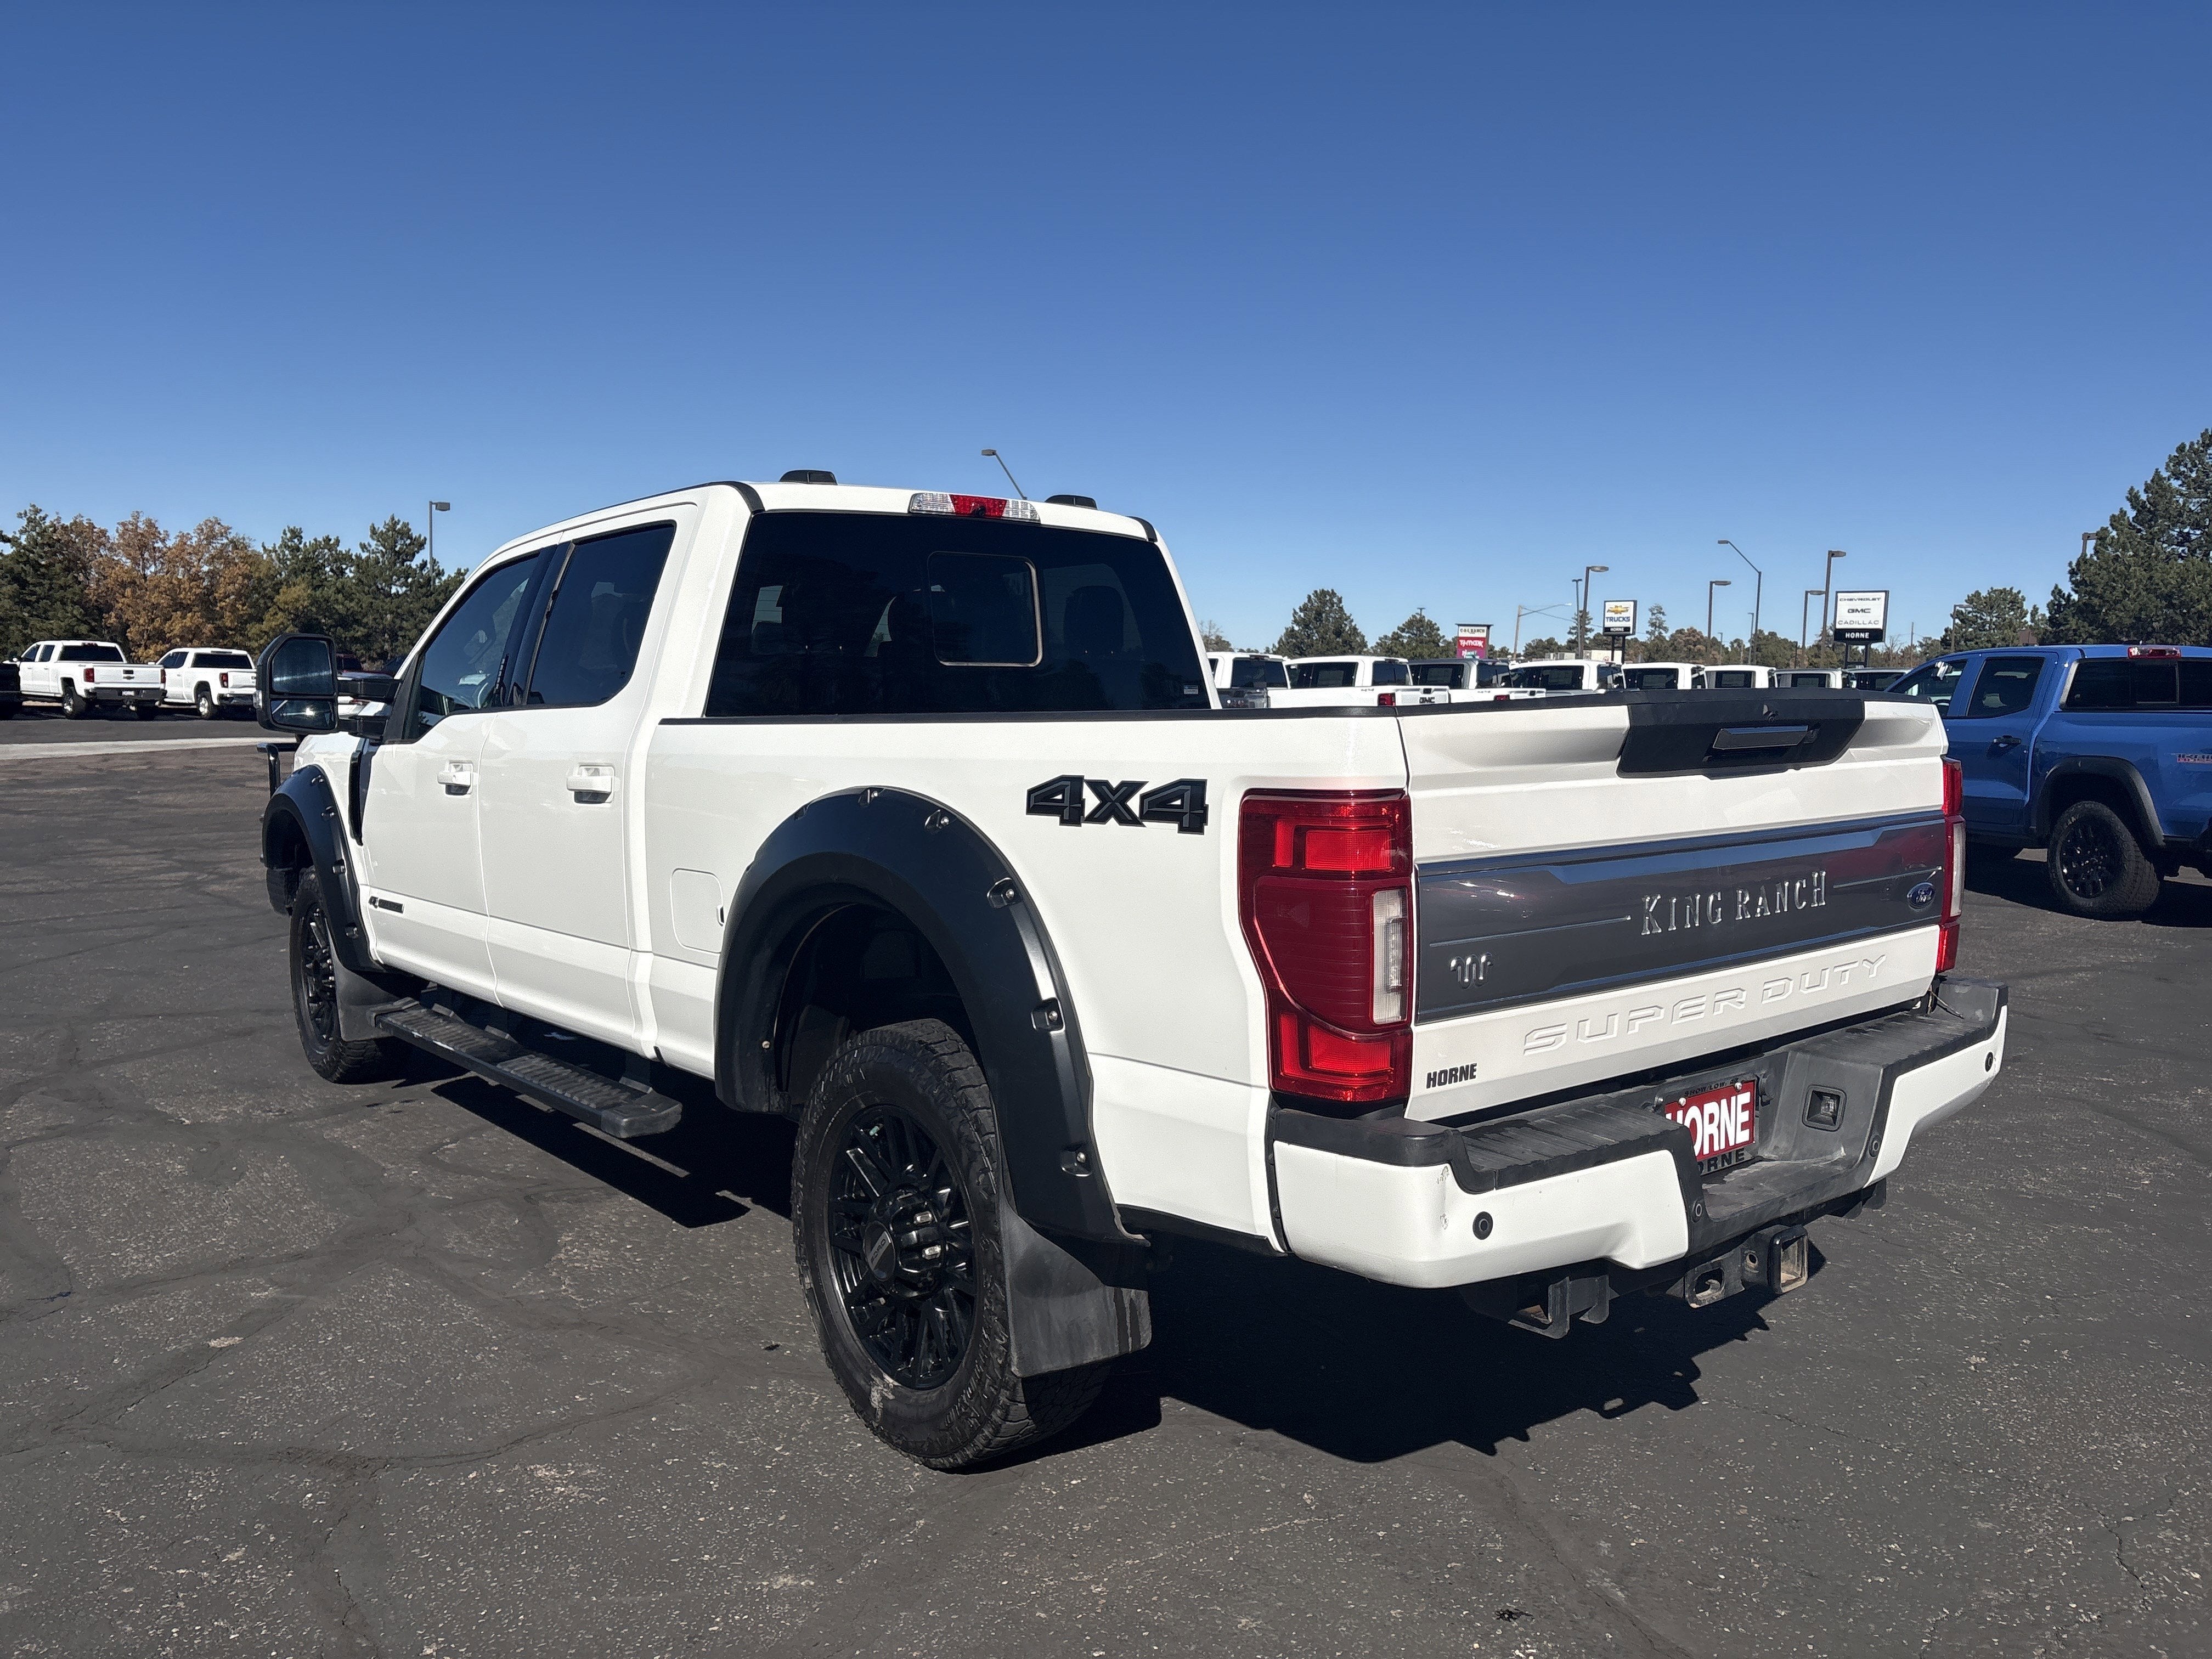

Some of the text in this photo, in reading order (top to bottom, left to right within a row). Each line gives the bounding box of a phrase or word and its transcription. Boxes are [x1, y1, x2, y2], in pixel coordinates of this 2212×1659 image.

[1641, 870, 1826, 935] KING RANCH
[1523, 954, 1886, 1056] SUPER DUTY
[1426, 1063, 1477, 1089] HORNE
